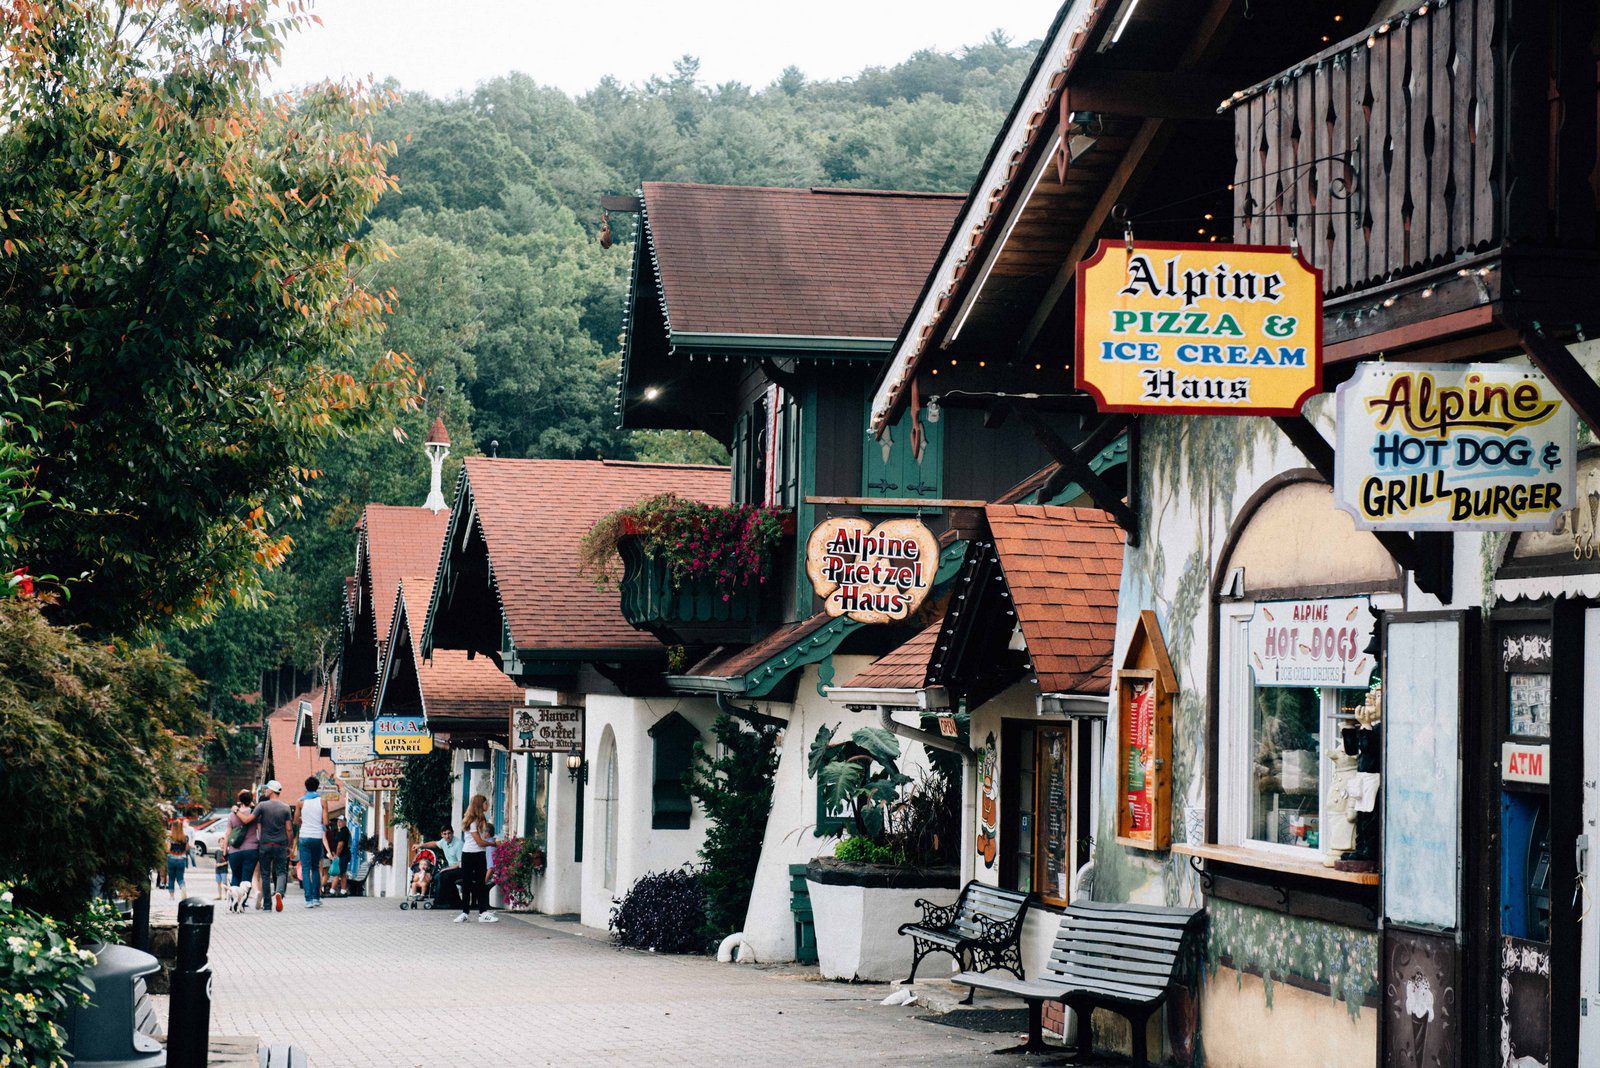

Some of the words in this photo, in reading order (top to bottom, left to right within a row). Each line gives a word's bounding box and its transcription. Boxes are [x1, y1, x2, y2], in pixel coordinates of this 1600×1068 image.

[1120, 256, 1282, 307] Alpine
[1112, 310, 1244, 337] PIZZA
[1264, 315, 1297, 337] &
[1101, 341, 1160, 362] ICE
[1176, 343, 1305, 366] CREAM
[1143, 369, 1248, 400] Haus
[1369, 375, 1555, 438] Alpine
[1373, 434, 1449, 467] HOT
[1456, 438, 1532, 466] DOG
[1543, 441, 1562, 470] &
[1363, 470, 1453, 517] GRILL
[1451, 482, 1562, 521] BURGER
[826, 527, 919, 562] Alpine
[1573, 533, 1600, 561] 86
[821, 555, 927, 588] Pretzel
[833, 585, 913, 613] Haus
[1293, 605, 1328, 621] ALPINE
[1265, 627, 1299, 660] HOT
[1310, 626, 1360, 662] DOGS
[1294, 666, 1311, 681] COLD
[378, 720, 419, 733] HGA
[538, 709, 579, 722] Hansel
[326, 726, 366, 734] HELEN'S
[531, 739, 554, 748] Candy
[540, 726, 576, 739] Gretel
[1508, 751, 1543, 777] ATM
